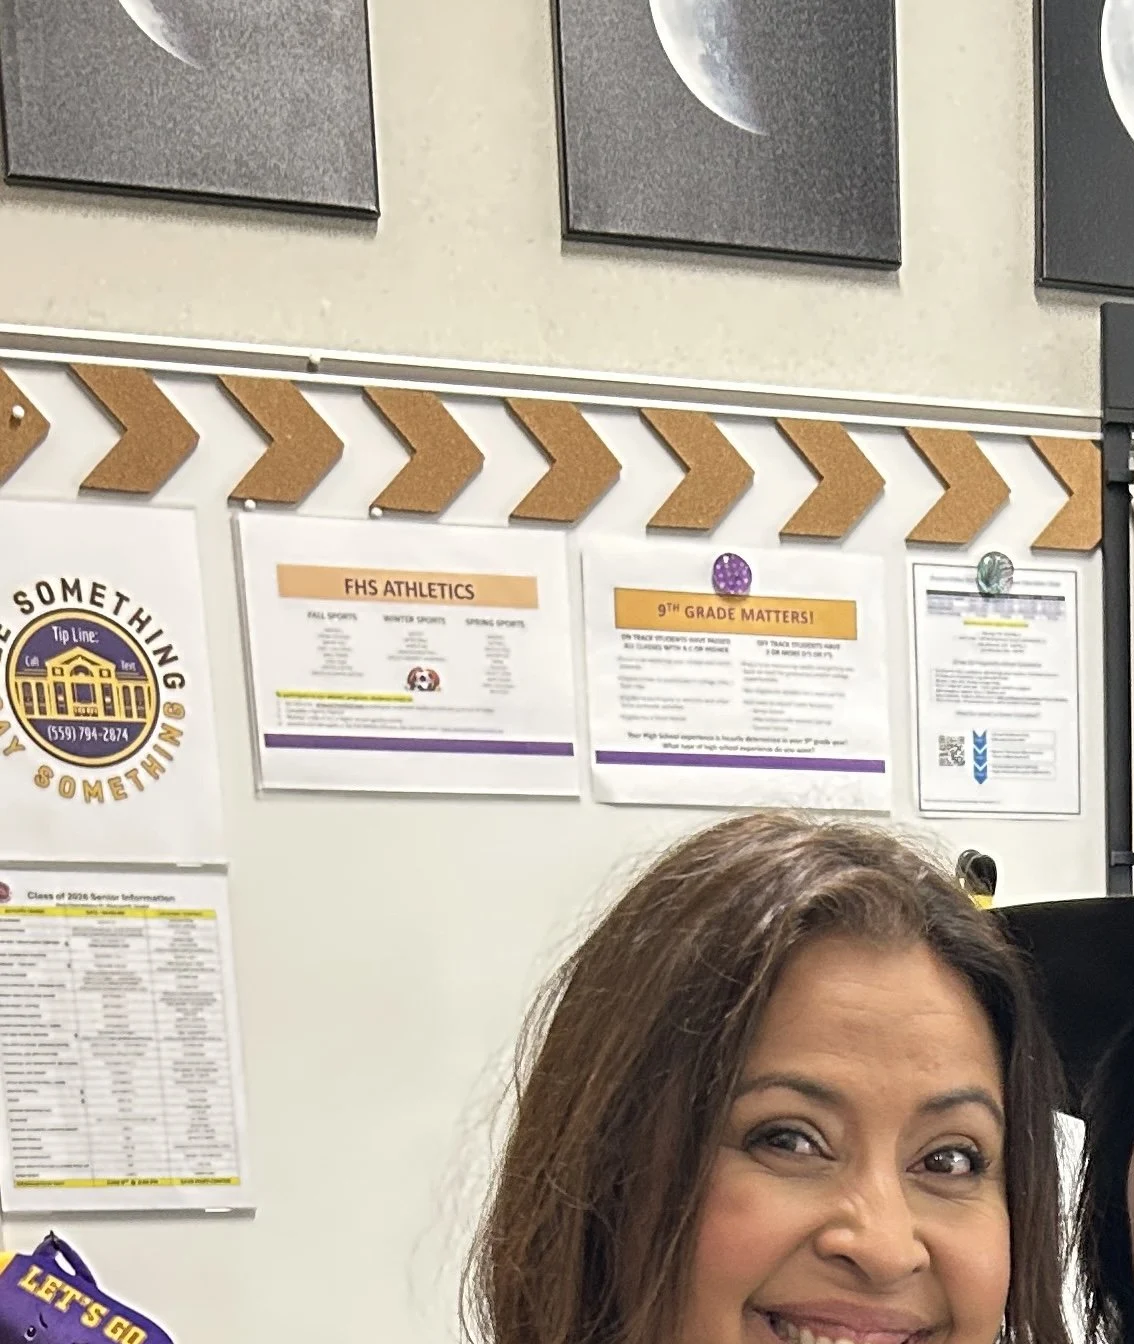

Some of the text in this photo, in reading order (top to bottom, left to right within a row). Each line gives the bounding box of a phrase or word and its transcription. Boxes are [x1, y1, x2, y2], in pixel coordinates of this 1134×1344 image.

[344, 578, 475, 601] FHS ATHLETICS
[307, 611, 358, 622] FALL SPORTS
[383, 615, 446, 625] WINTER SPORTS
[657, 602, 815, 625] 9TH GRADE MATTERS!
[13, 577, 186, 690] SOMETHING
[52, 626, 99, 645] Tip Line:
[25, 655, 39, 667] Call
[47, 725, 129, 742] (559) 794-2874
[34, 702, 186, 804] SOMETHING
[27, 891, 54, 901] Class
[56, 891, 66, 900] of
[90, 892, 119, 902] Senior
[121, 893, 176, 903] Information
[16, 1263, 111, 1329] LET'S
